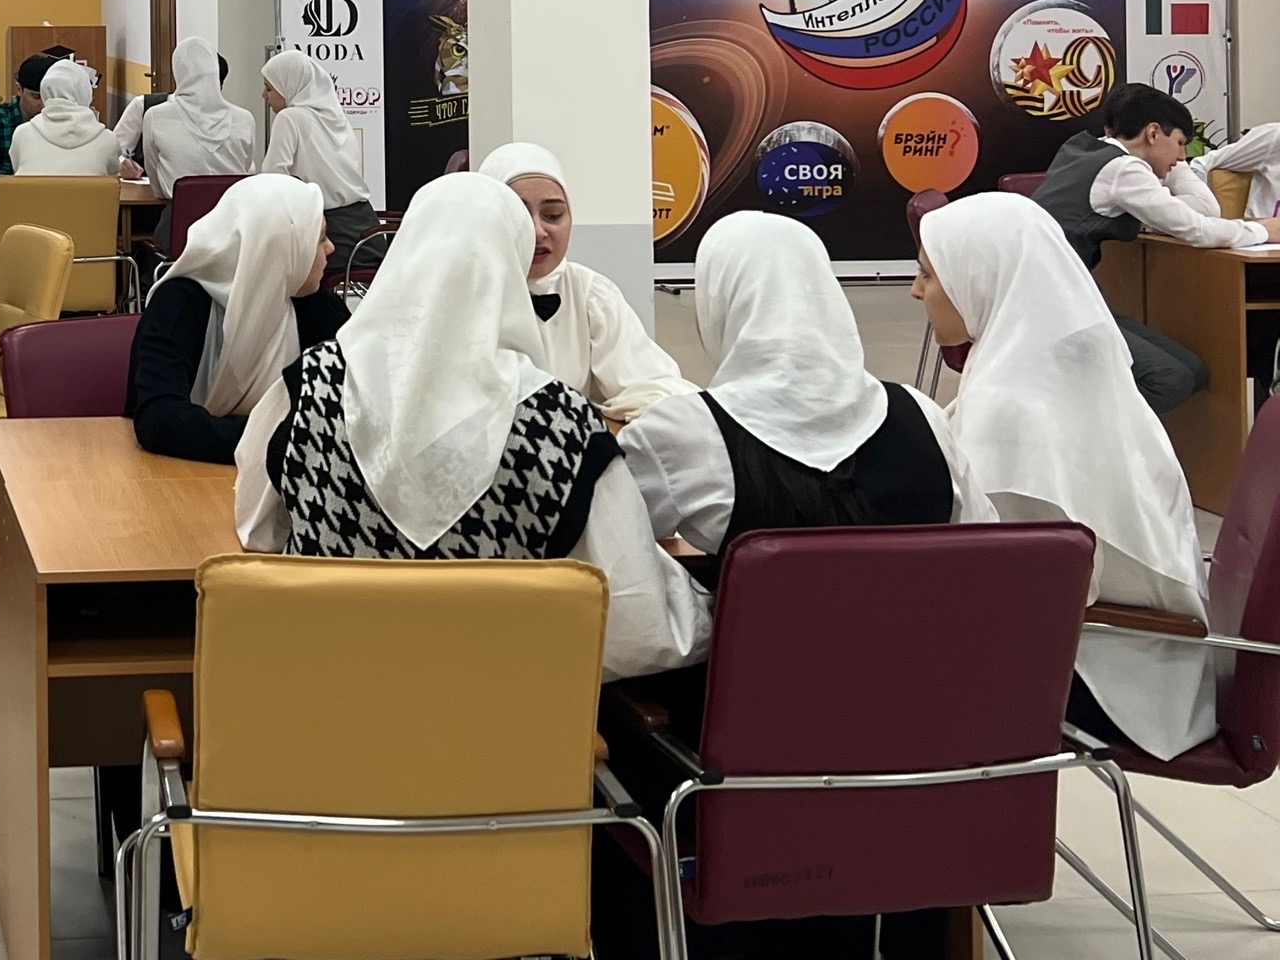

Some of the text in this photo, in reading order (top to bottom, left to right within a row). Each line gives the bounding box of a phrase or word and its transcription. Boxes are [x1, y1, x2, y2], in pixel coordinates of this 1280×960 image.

[334, 86, 381, 106] HOP
[436, 101, 458, 120] ЧТО?
[893, 131, 948, 145] БРЭЙН
[902, 145, 945, 157] РИНГ
[783, 164, 844, 181] СВОЯ
